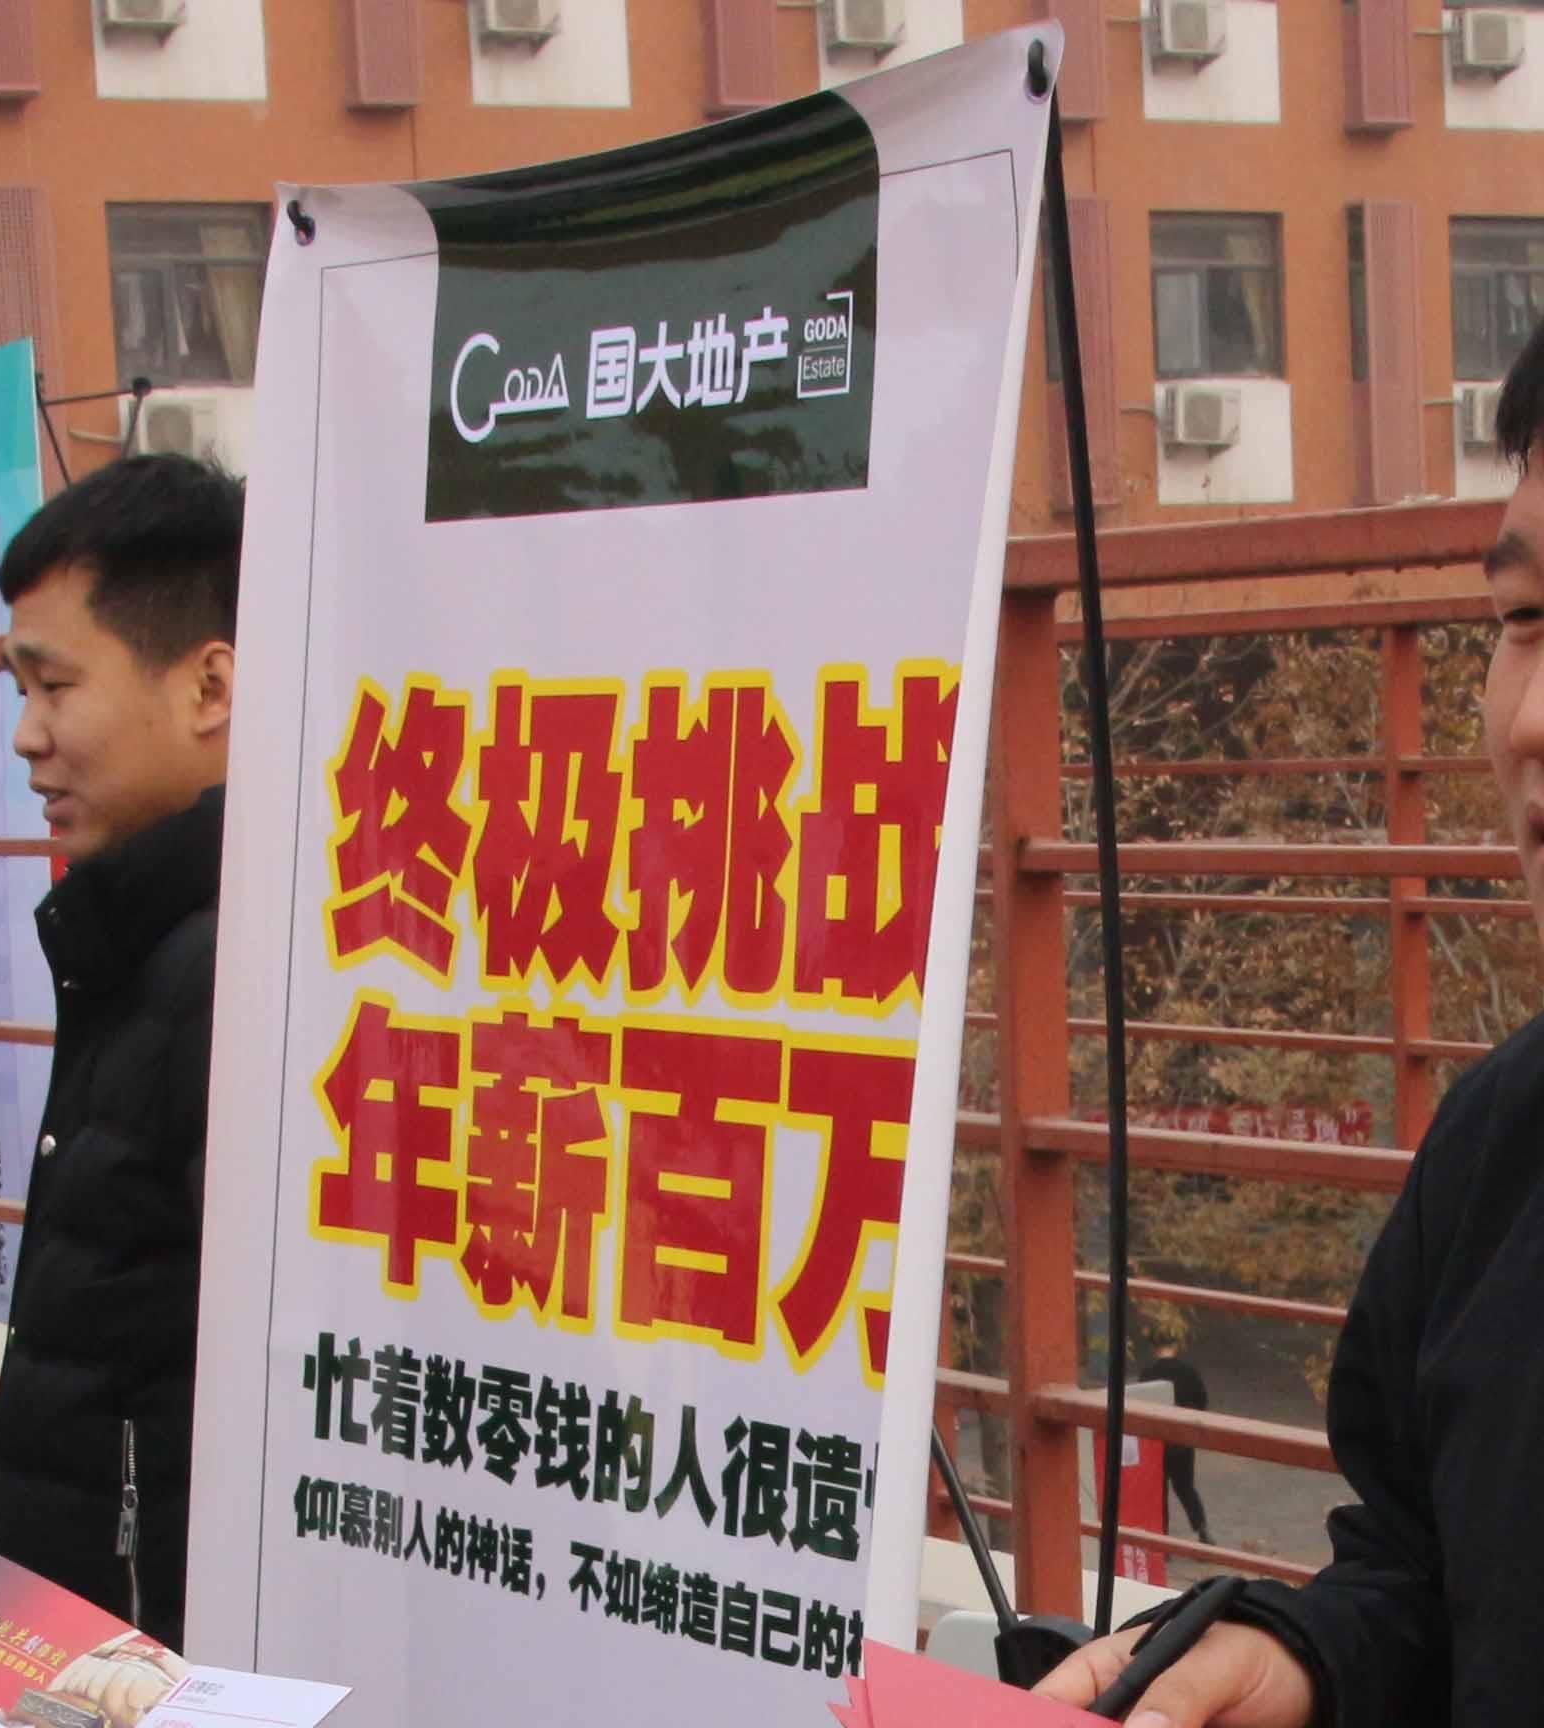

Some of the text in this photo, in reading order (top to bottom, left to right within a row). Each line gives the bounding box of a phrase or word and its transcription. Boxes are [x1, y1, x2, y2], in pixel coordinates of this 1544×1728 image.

[586, 306, 789, 419] 国大地产
[802, 355, 846, 380] Estate
[804, 315, 847, 342] GODA
[325, 664, 961, 1012] 终极挑战
[310, 990, 919, 1390] 年薪百万
[304, 1332, 878, 1561] 忙着数零钱的人很遗
